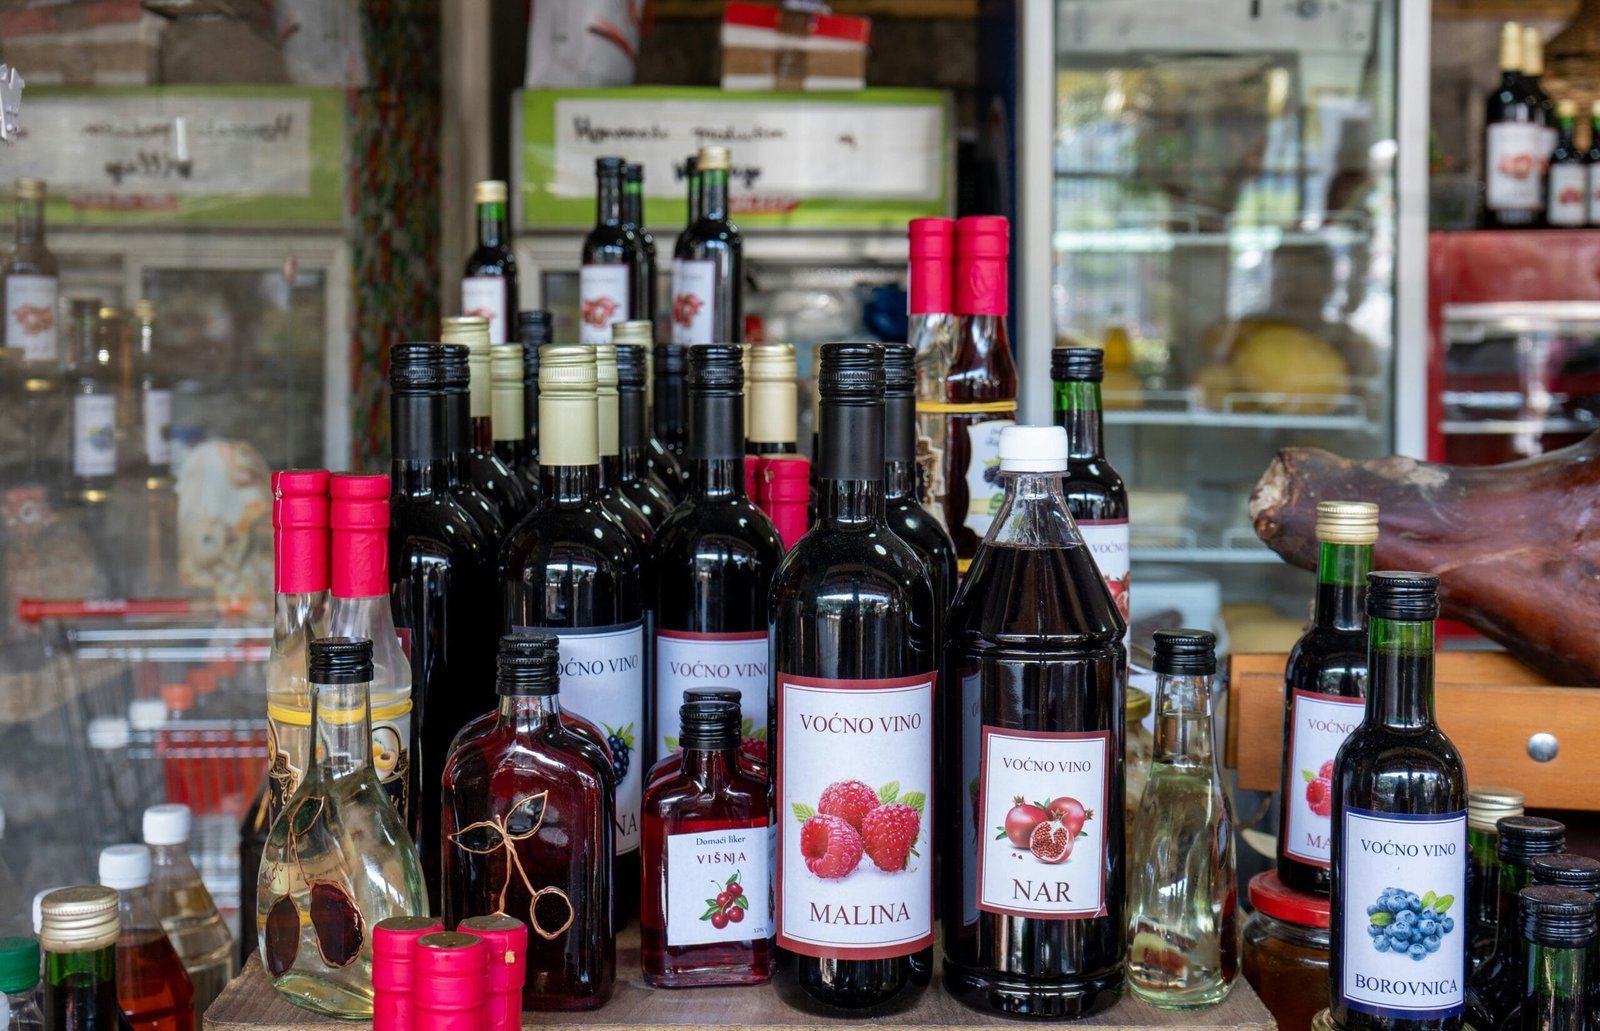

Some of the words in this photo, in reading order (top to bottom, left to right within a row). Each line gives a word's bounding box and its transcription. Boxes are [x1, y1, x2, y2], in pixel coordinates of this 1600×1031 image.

[559, 657, 604, 677] ĆNO
[608, 653, 639, 673] VINO
[669, 660, 730, 679] VOĆNO
[800, 712, 874, 735] VOĆNO
[880, 713, 921, 733] VINO
[1003, 756, 1054, 773] VOĆNO
[1059, 760, 1091, 773] VINO
[728, 834, 746, 844] liker
[1361, 839, 1419, 857] VOĆNO
[1423, 843, 1456, 857] VINO
[1012, 878, 1073, 903] NAR
[809, 901, 911, 926] MALINA
[1355, 973, 1458, 996] BOROVNICA
